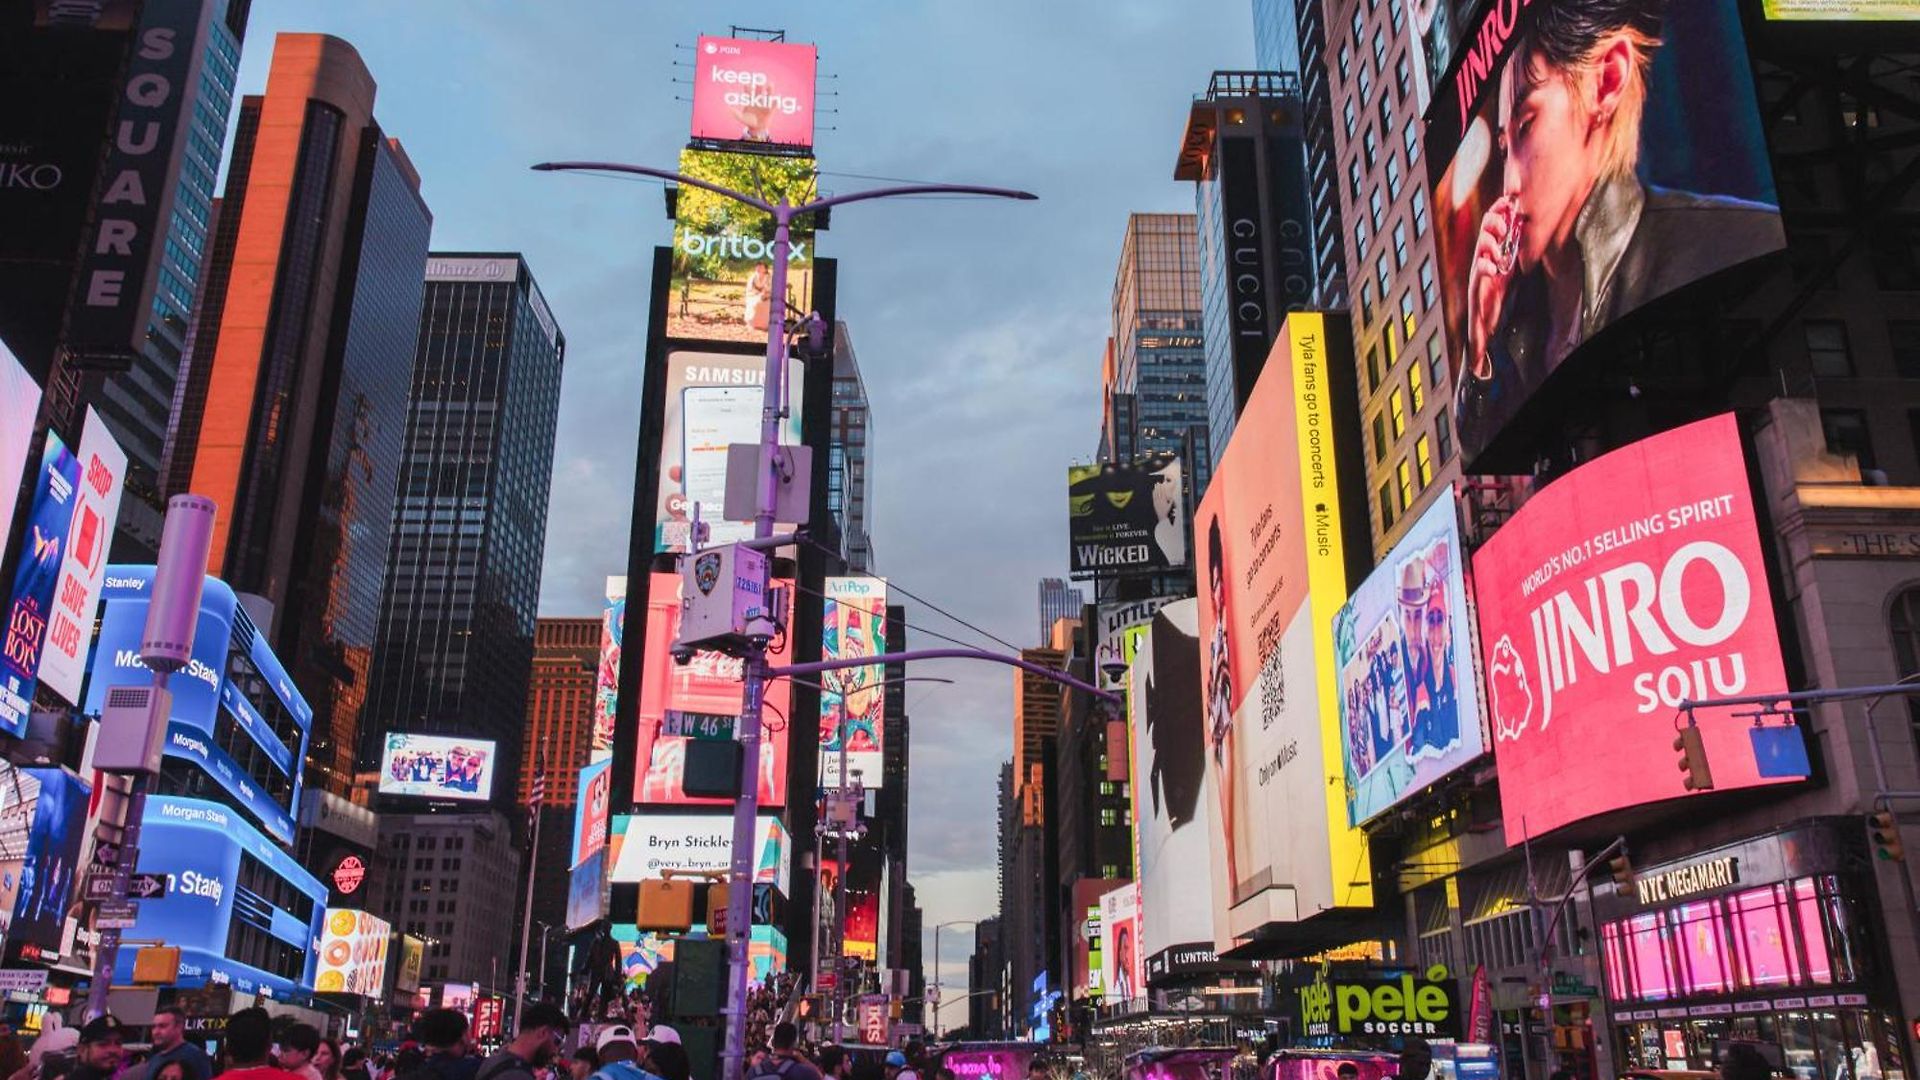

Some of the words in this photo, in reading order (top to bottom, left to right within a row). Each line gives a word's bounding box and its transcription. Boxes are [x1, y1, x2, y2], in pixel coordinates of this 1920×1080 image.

[712, 65, 767, 88] keep
[1456, 0, 1519, 139] JINRO
[724, 90, 802, 114] asking.
[86, 26, 177, 307] SQUARE
[1233, 218, 1263, 336] GUCCI
[1299, 333, 1316, 361] Tyla
[685, 365, 766, 384] SAMSU
[1304, 361, 1316, 390] fans
[1304, 392, 1318, 411] go
[1308, 412, 1319, 428] to
[87, 453, 113, 499] SHOP
[1309, 429, 1324, 489] concerts
[1316, 515, 1330, 556] Music
[1521, 555, 1561, 598] WORLD'S
[1562, 540, 1593, 571] NO.1
[1595, 514, 1665, 555] SELLING
[1668, 494, 1734, 530] SPIRIT
[1846, 534, 1898, 554] THE
[61, 573, 88, 619] SAVE
[105, 576, 146, 590] Stanley
[10, 602, 45, 649] LOST
[50, 611, 81, 659] LIVES
[1109, 602, 1156, 633] LITTLE
[1530, 540, 1751, 732] JINRO
[1633, 652, 1747, 713] SOJU
[684, 714, 696, 735] W
[700, 717, 719, 736] 46
[162, 804, 205, 821] Morgan
[649, 835, 680, 850] Bryn
[685, 835, 733, 848] Stickle
[1638, 875, 1667, 905] NYC
[1666, 857, 1733, 898] MEGAMART
[1336, 963, 1449, 1034] pelé
[1363, 1022, 1437, 1034] SOCCER
